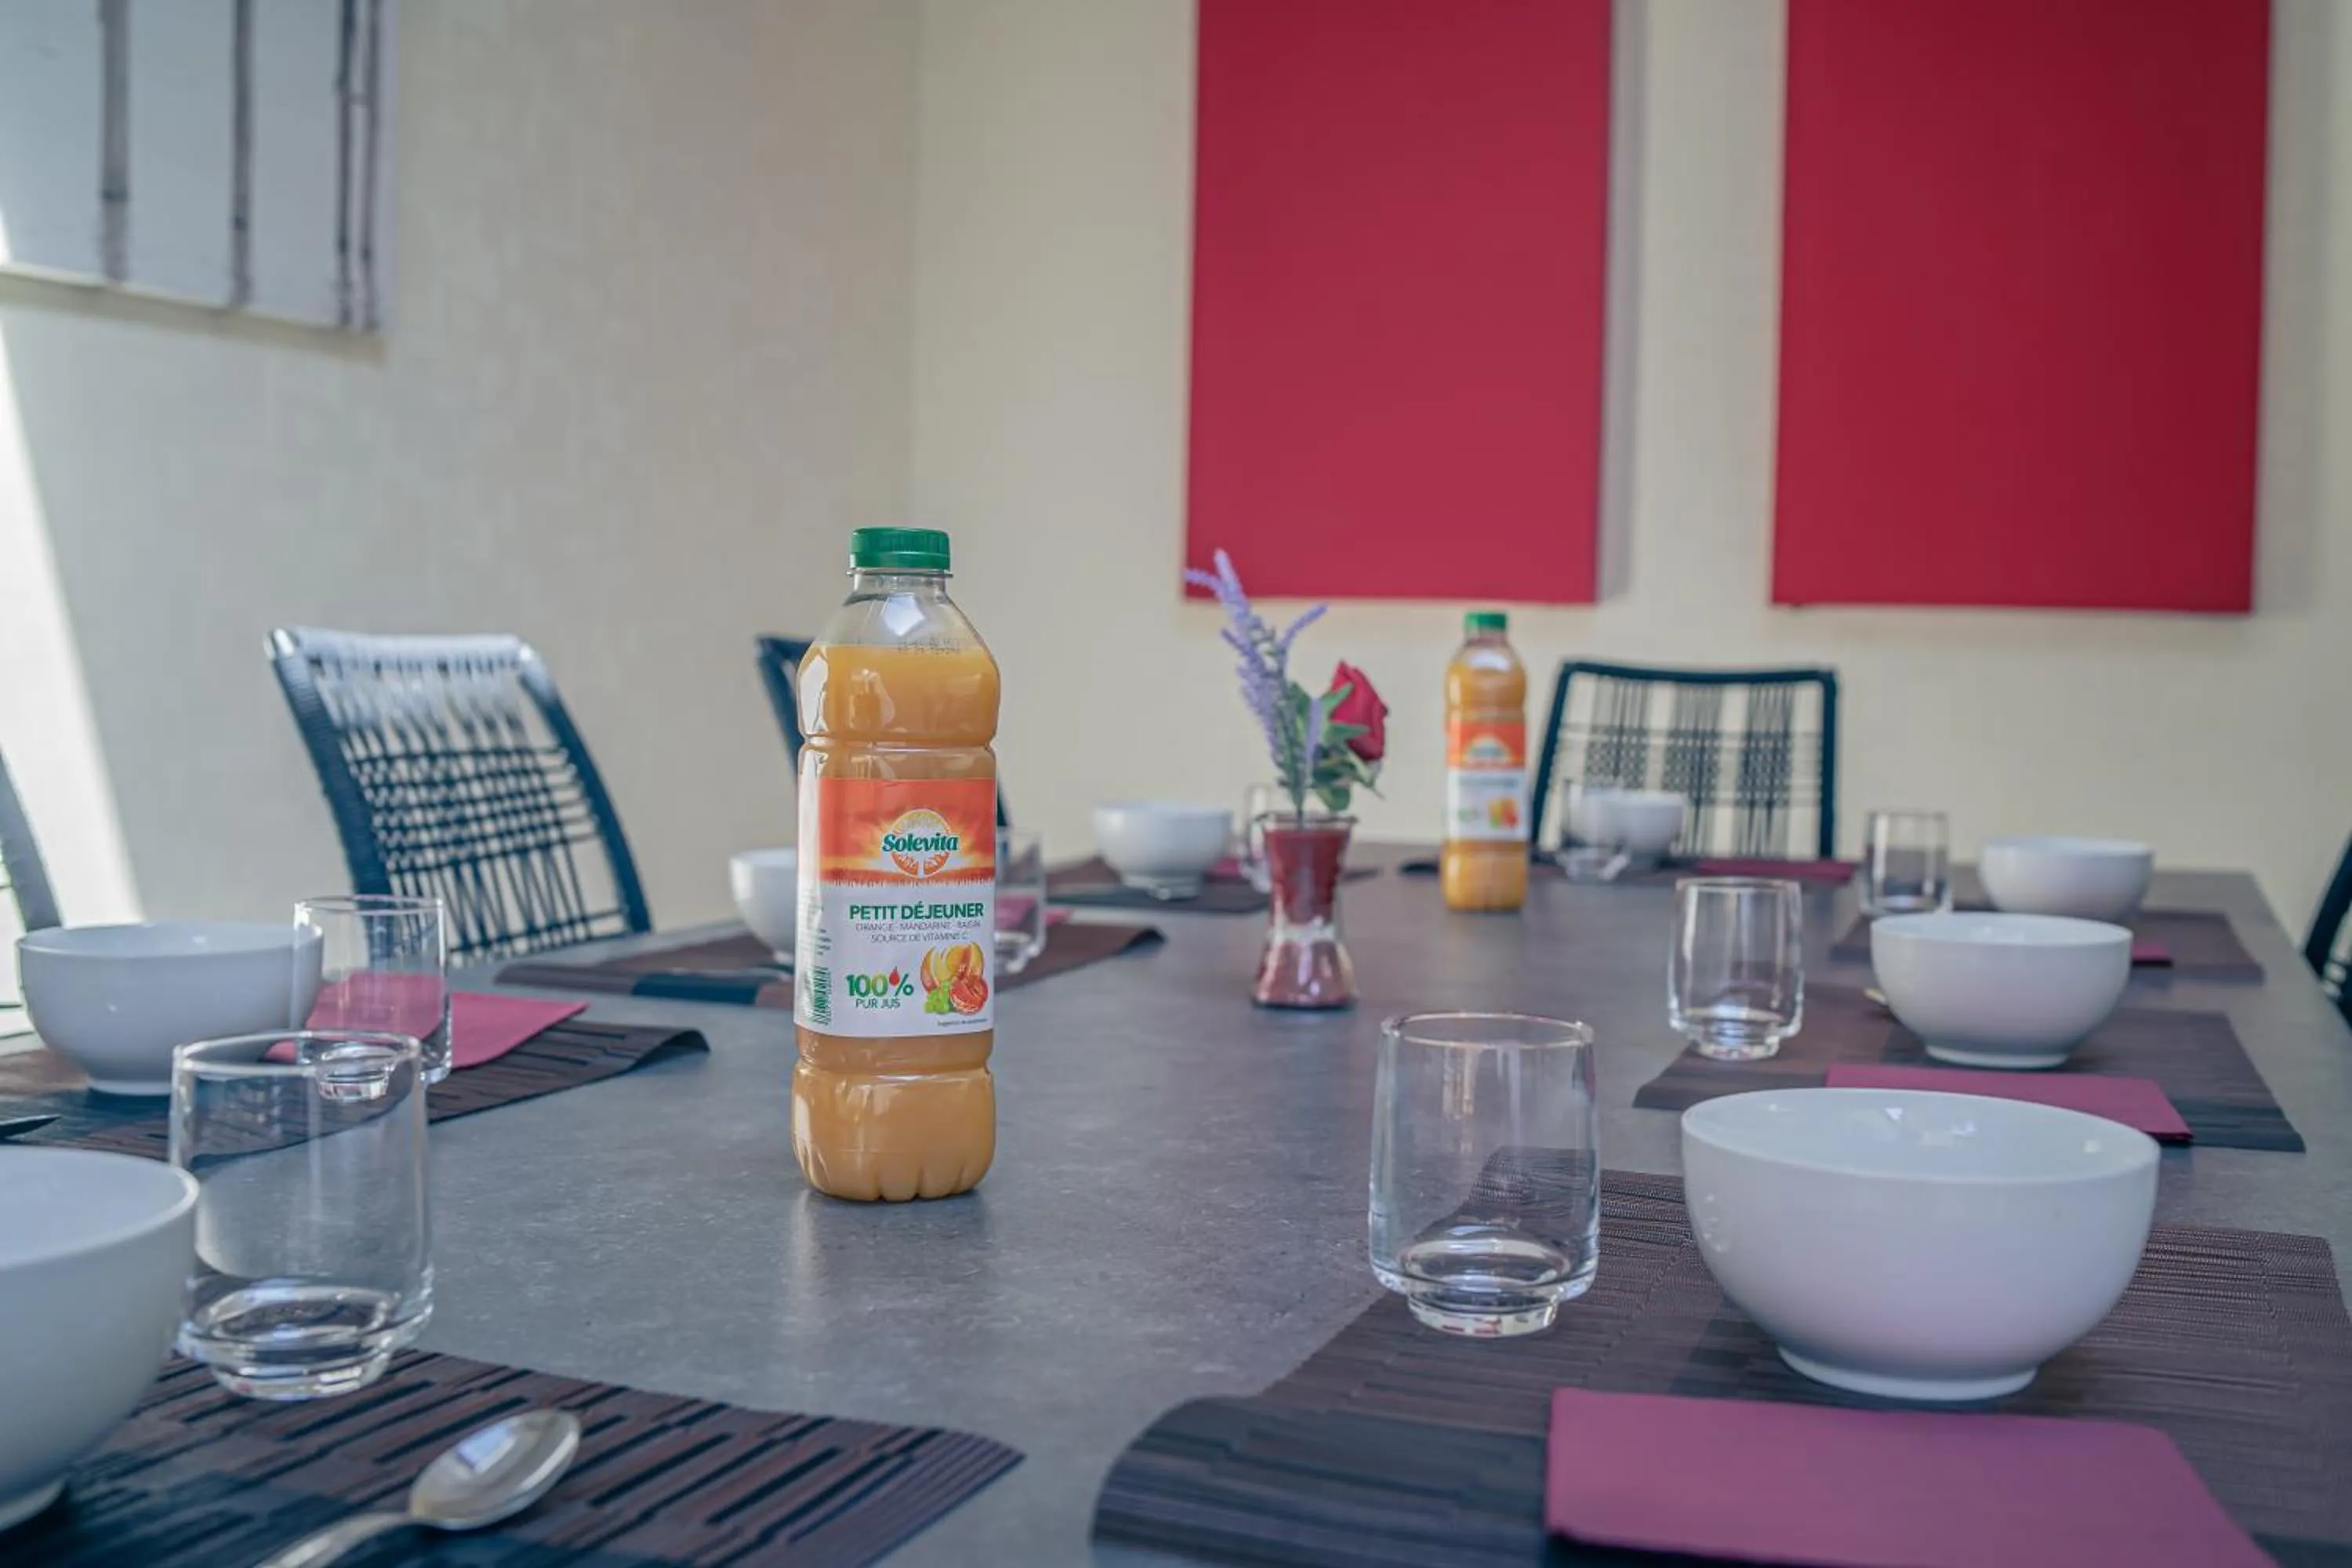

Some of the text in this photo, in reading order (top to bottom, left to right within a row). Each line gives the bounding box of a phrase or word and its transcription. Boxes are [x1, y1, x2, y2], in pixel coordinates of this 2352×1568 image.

[882, 833, 959, 852] Solevita
[849, 901, 984, 920] PETIT DÉJEUNER
[846, 967, 914, 997] 100%
[855, 998, 901, 1009] PUR JUS
